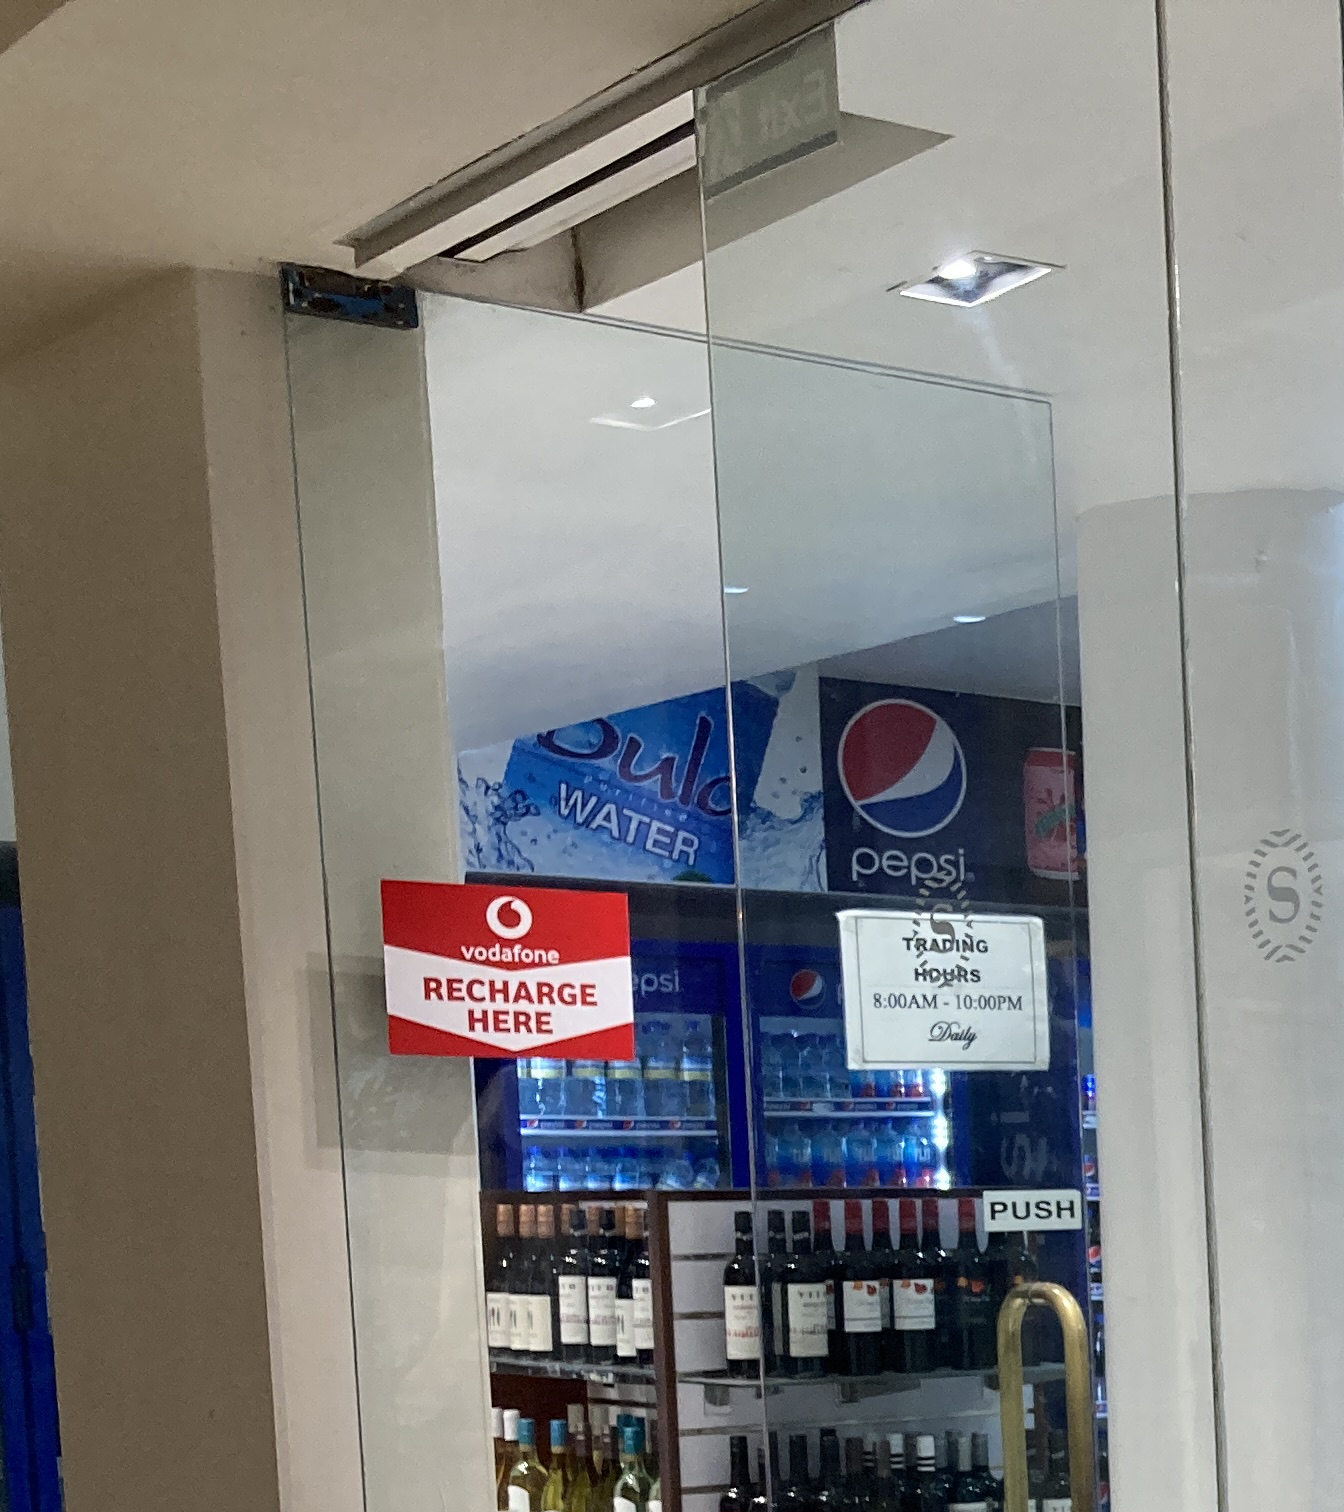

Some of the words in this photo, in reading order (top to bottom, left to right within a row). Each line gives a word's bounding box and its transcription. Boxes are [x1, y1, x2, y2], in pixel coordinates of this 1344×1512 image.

[557, 781, 700, 867] WATER
[851, 847, 965, 887] pepsi
[460, 943, 560, 965] vodafone
[902, 937, 989, 953] TRADING
[914, 968, 982, 984] HOURS
[423, 977, 599, 1007] RECHARGE
[873, 992, 938, 1010] 8:00AM
[955, 994, 1023, 1011] 10:00PM
[467, 1008, 554, 1035] HERE
[928, 1021, 978, 1050] Daily
[989, 1199, 1077, 1221] PUSH
